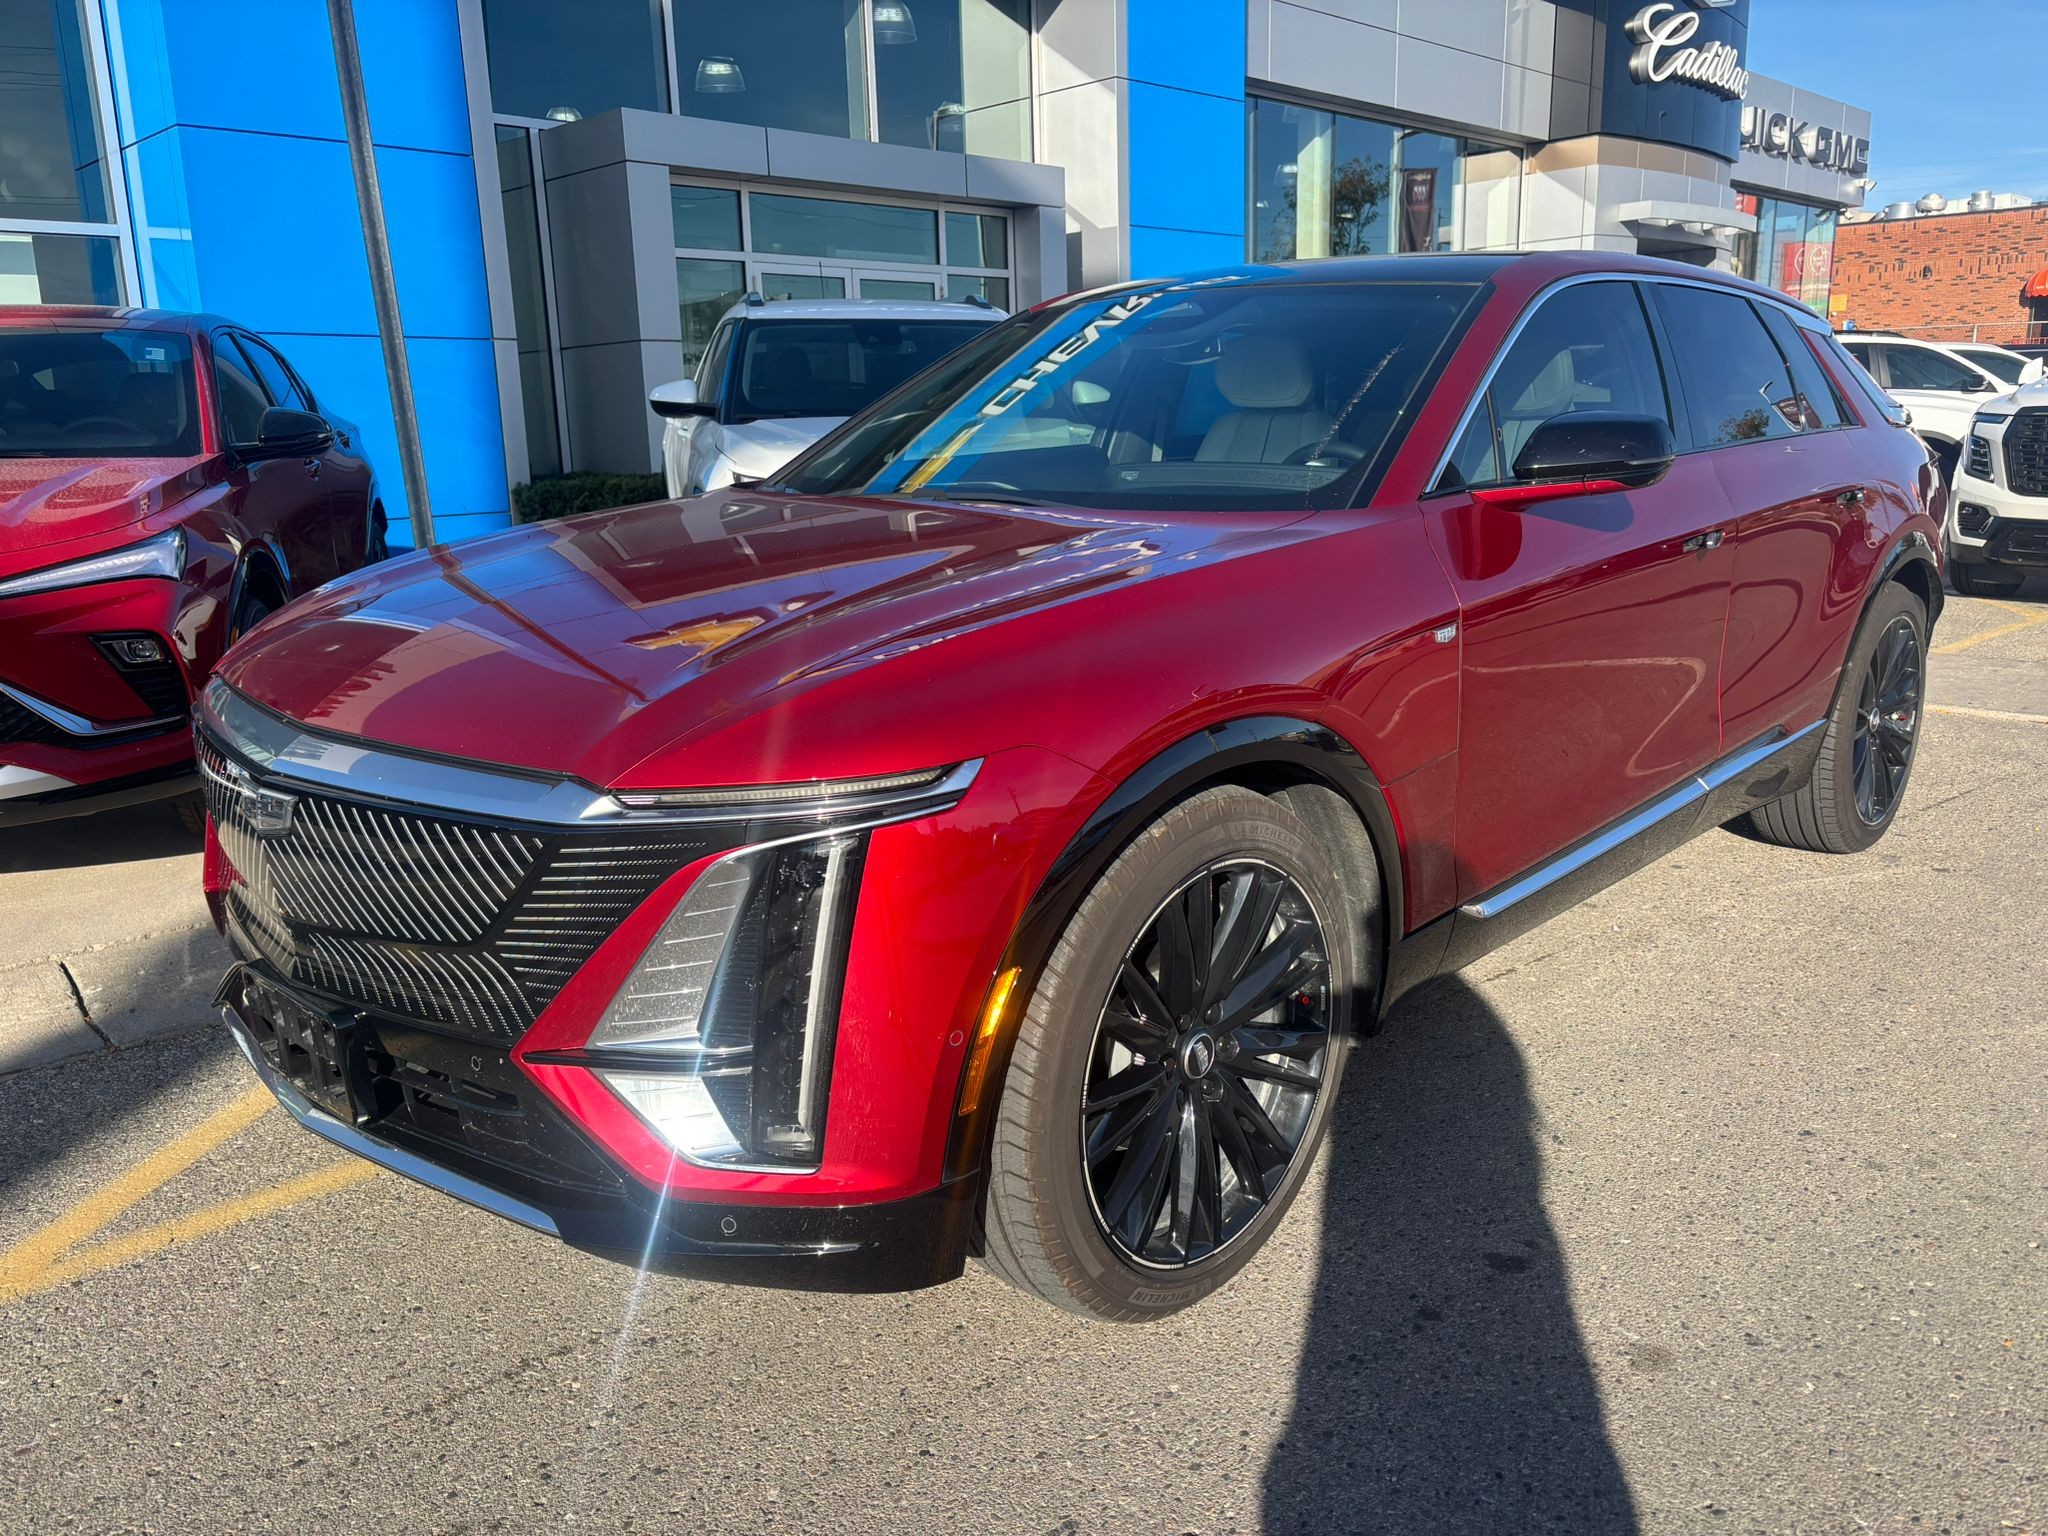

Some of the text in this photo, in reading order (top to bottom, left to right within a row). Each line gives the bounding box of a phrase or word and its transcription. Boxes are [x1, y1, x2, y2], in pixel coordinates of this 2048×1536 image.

[1640, 2, 1750, 101] Cadillac
[1741, 105, 1870, 172] UICK GMC
[1132, 1288, 1194, 1304] MICHELIN
